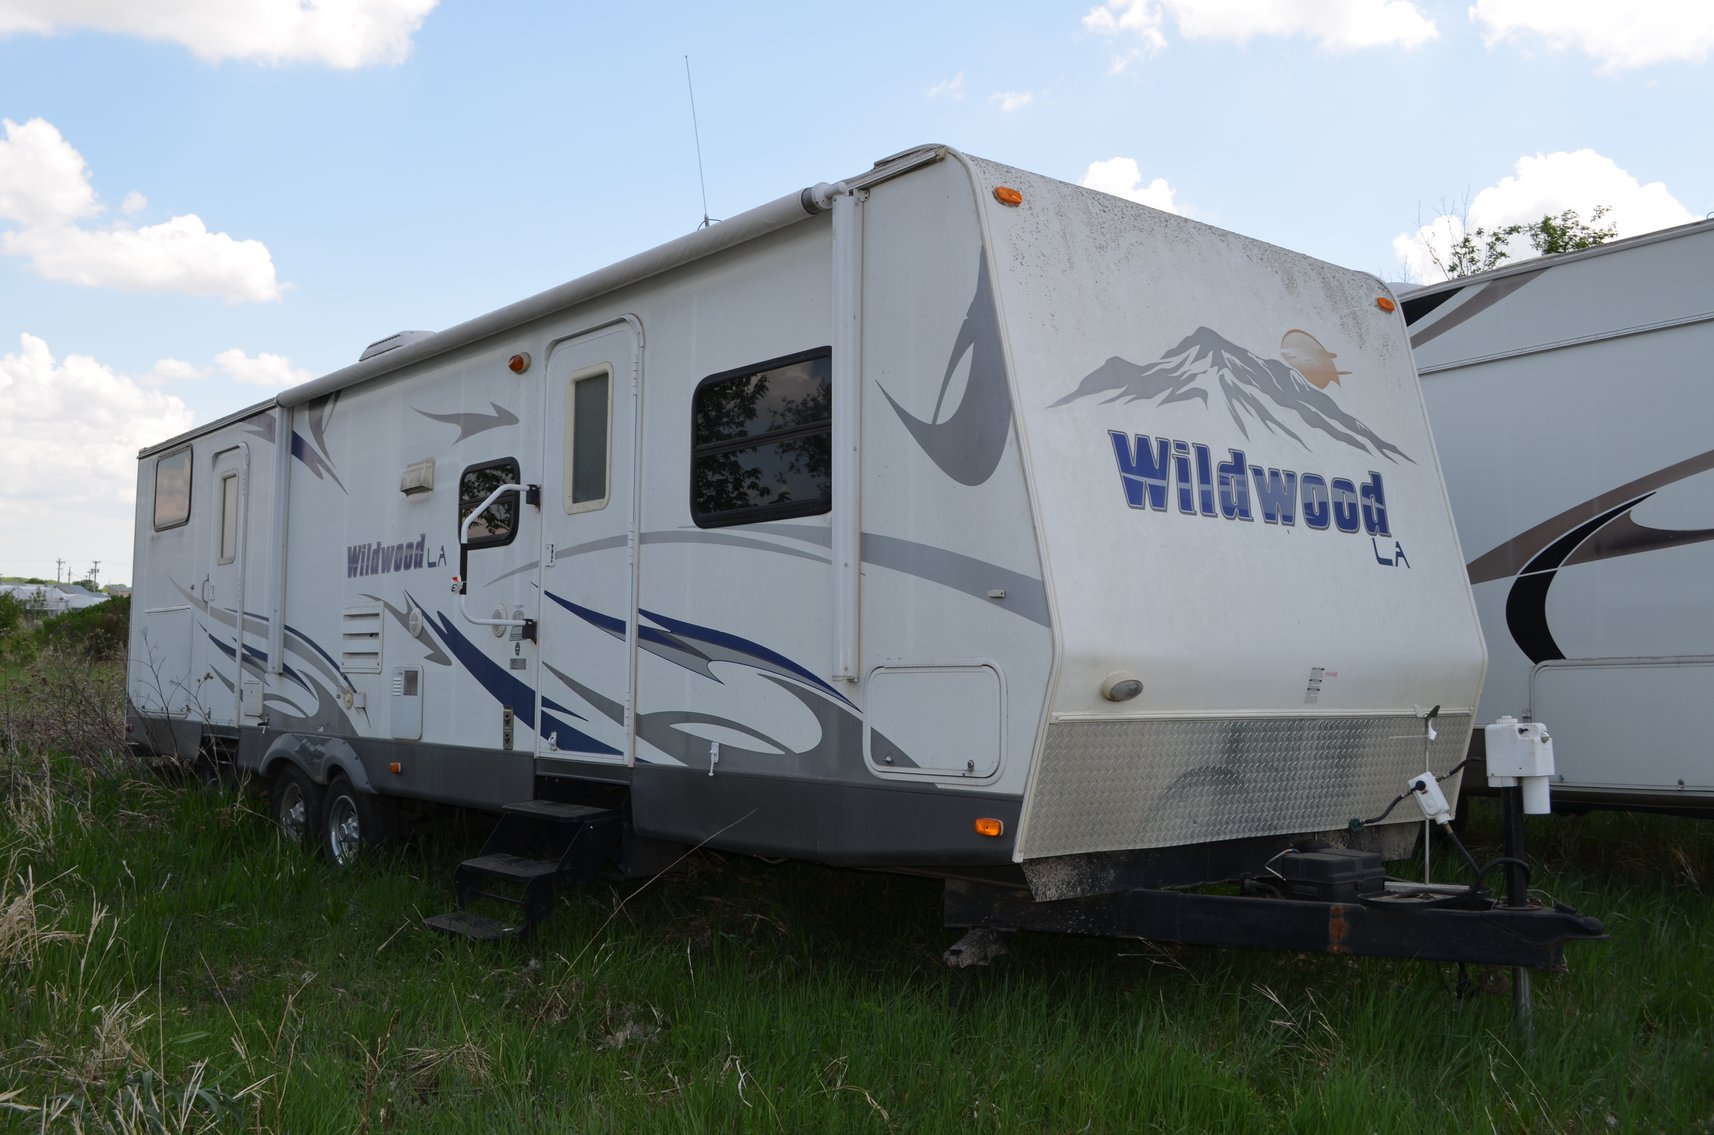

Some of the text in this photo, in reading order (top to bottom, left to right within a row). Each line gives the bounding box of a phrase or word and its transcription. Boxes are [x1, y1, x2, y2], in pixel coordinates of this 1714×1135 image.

[1107, 429, 1392, 537] Wildwood
[347, 533, 447, 578] Wildwood LA
[1372, 537, 1410, 568] LA
